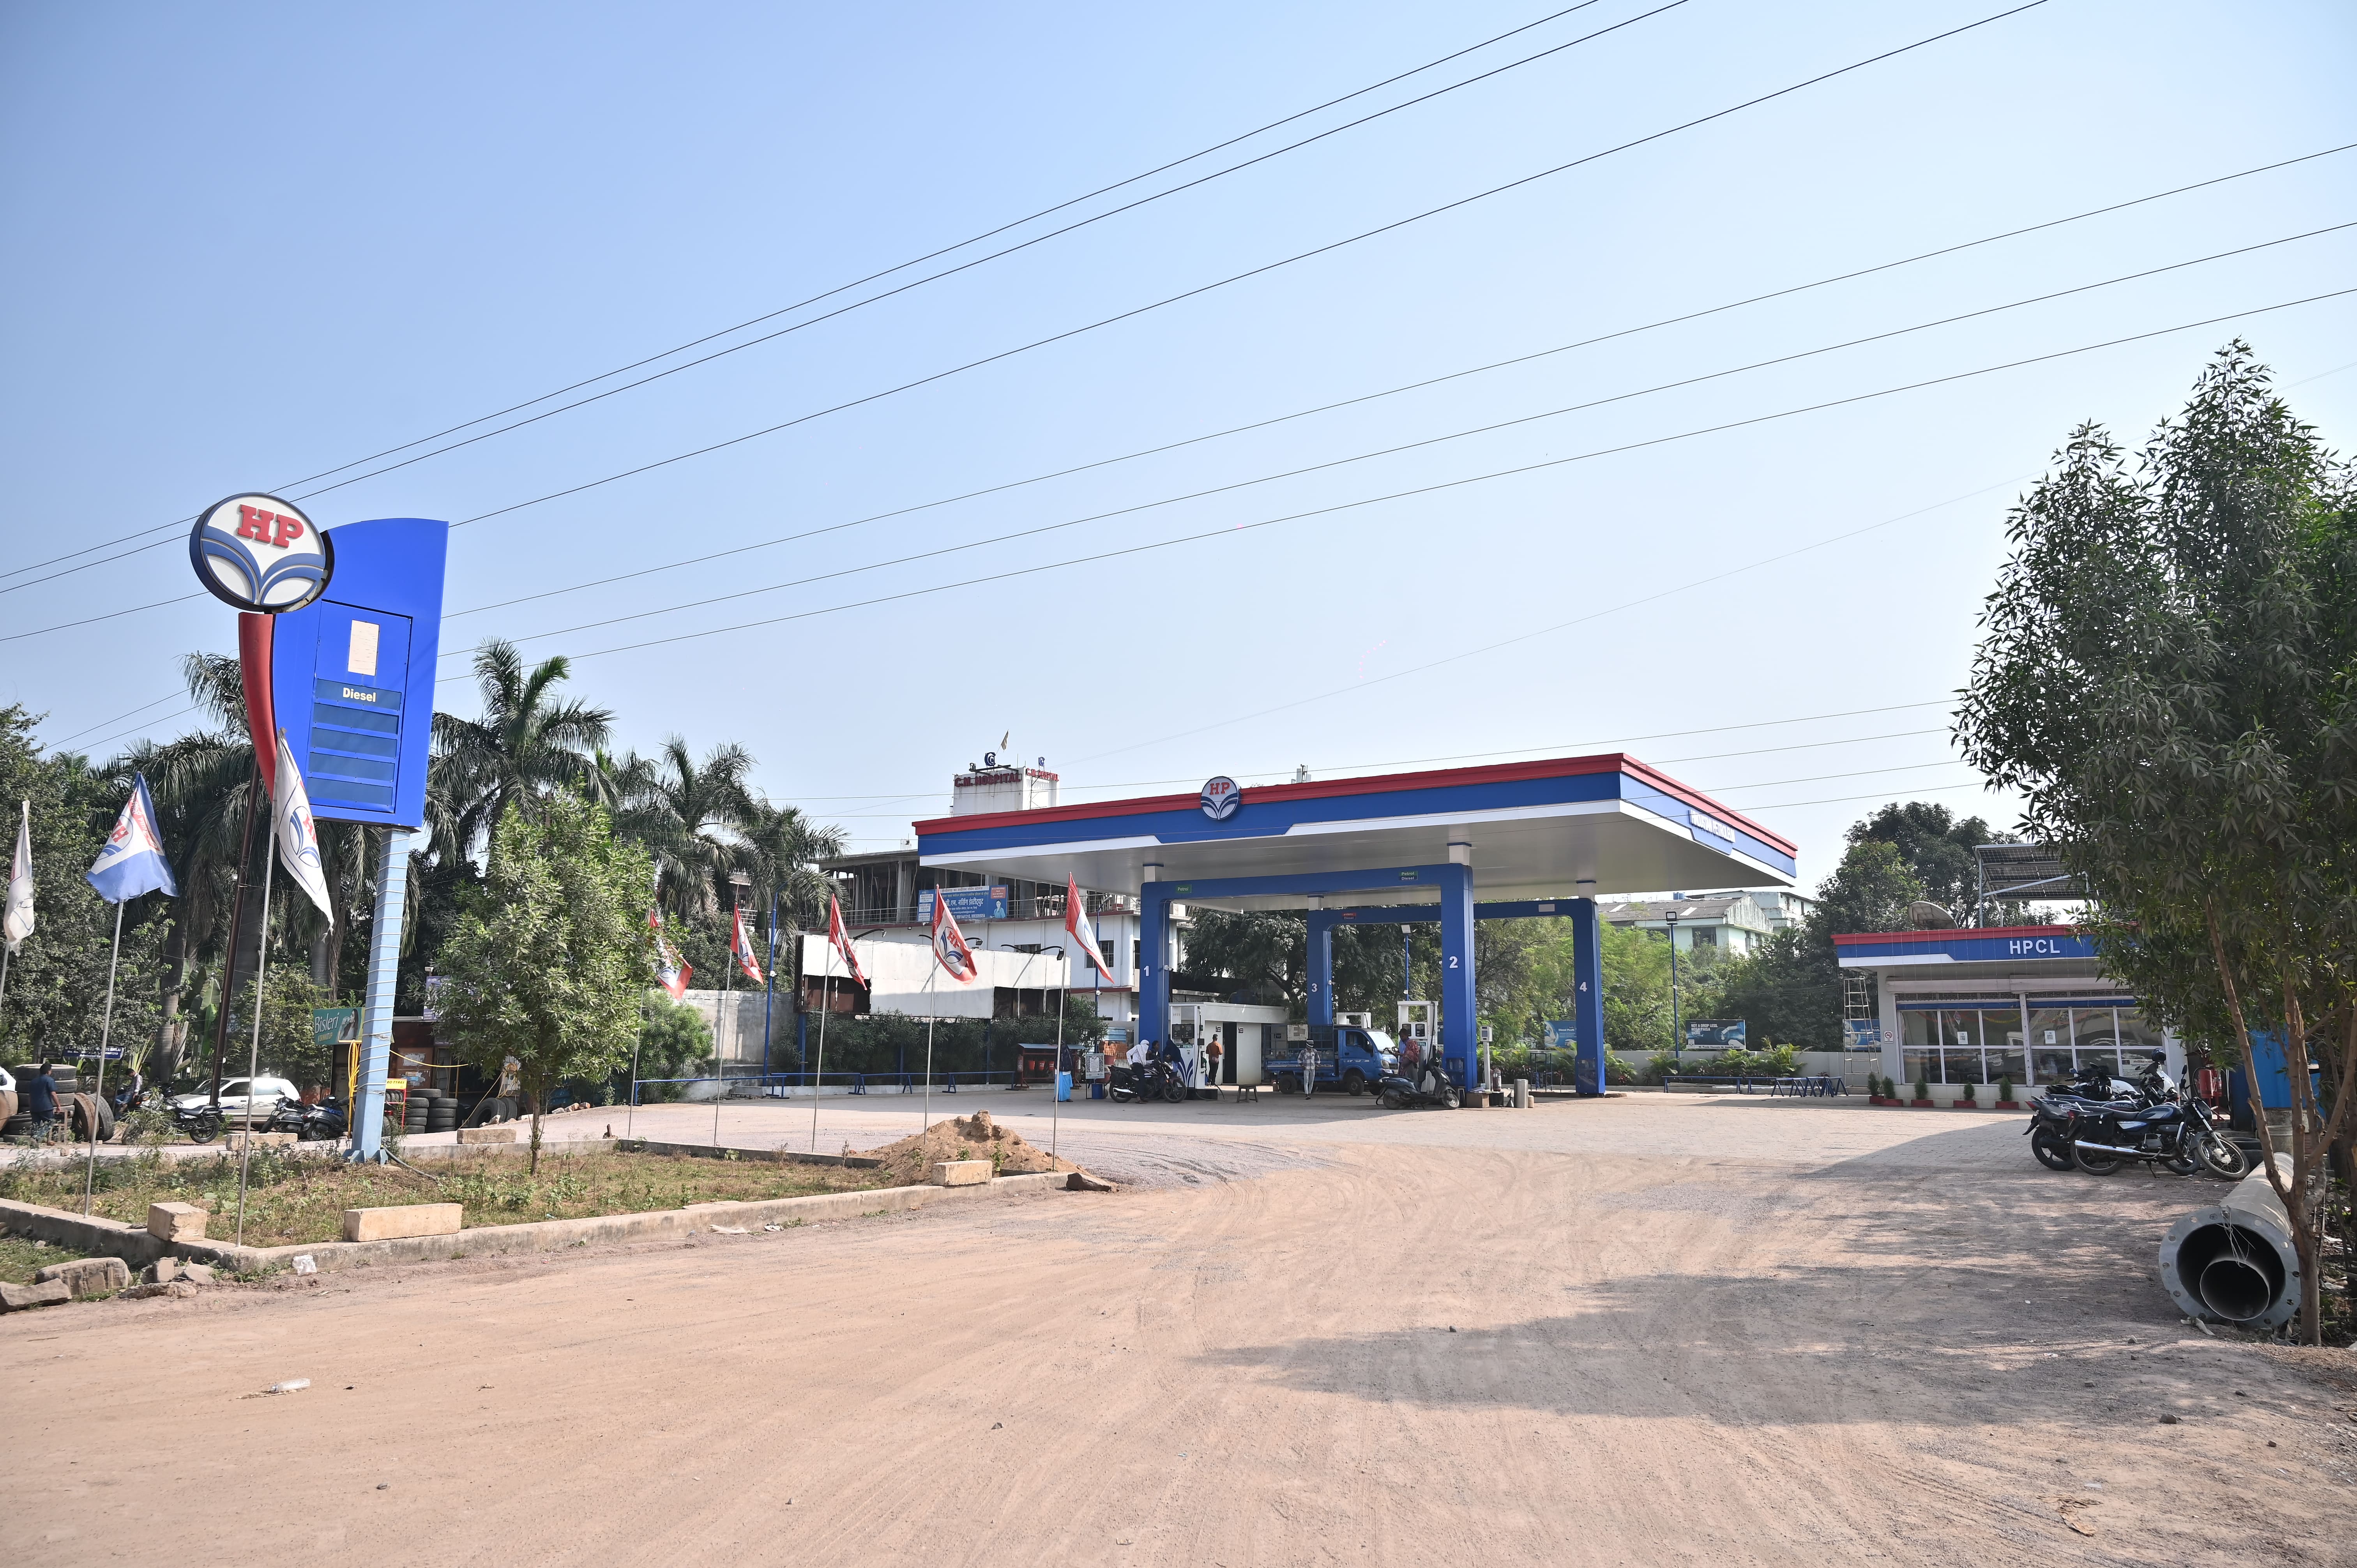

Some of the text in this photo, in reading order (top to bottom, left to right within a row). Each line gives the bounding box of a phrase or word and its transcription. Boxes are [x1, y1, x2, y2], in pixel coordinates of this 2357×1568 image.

[237, 504, 304, 548] HP
[343, 687, 376, 702] Diesel
[955, 773, 1021, 787] C.M. HOSPITAL
[1026, 768, 1059, 781] C.M. HOSPITAL
[1209, 782, 1230, 795] HP
[1690, 809, 1736, 842] HINDUSTAN PETROLEUM
[2009, 939, 2060, 954] HPCL
[1449, 956, 1458, 968] 2
[1144, 966, 1149, 976] 1
[1311, 983, 1318, 992] 3
[1580, 982, 1587, 992] 4
[315, 1012, 339, 1033] Bisleri
